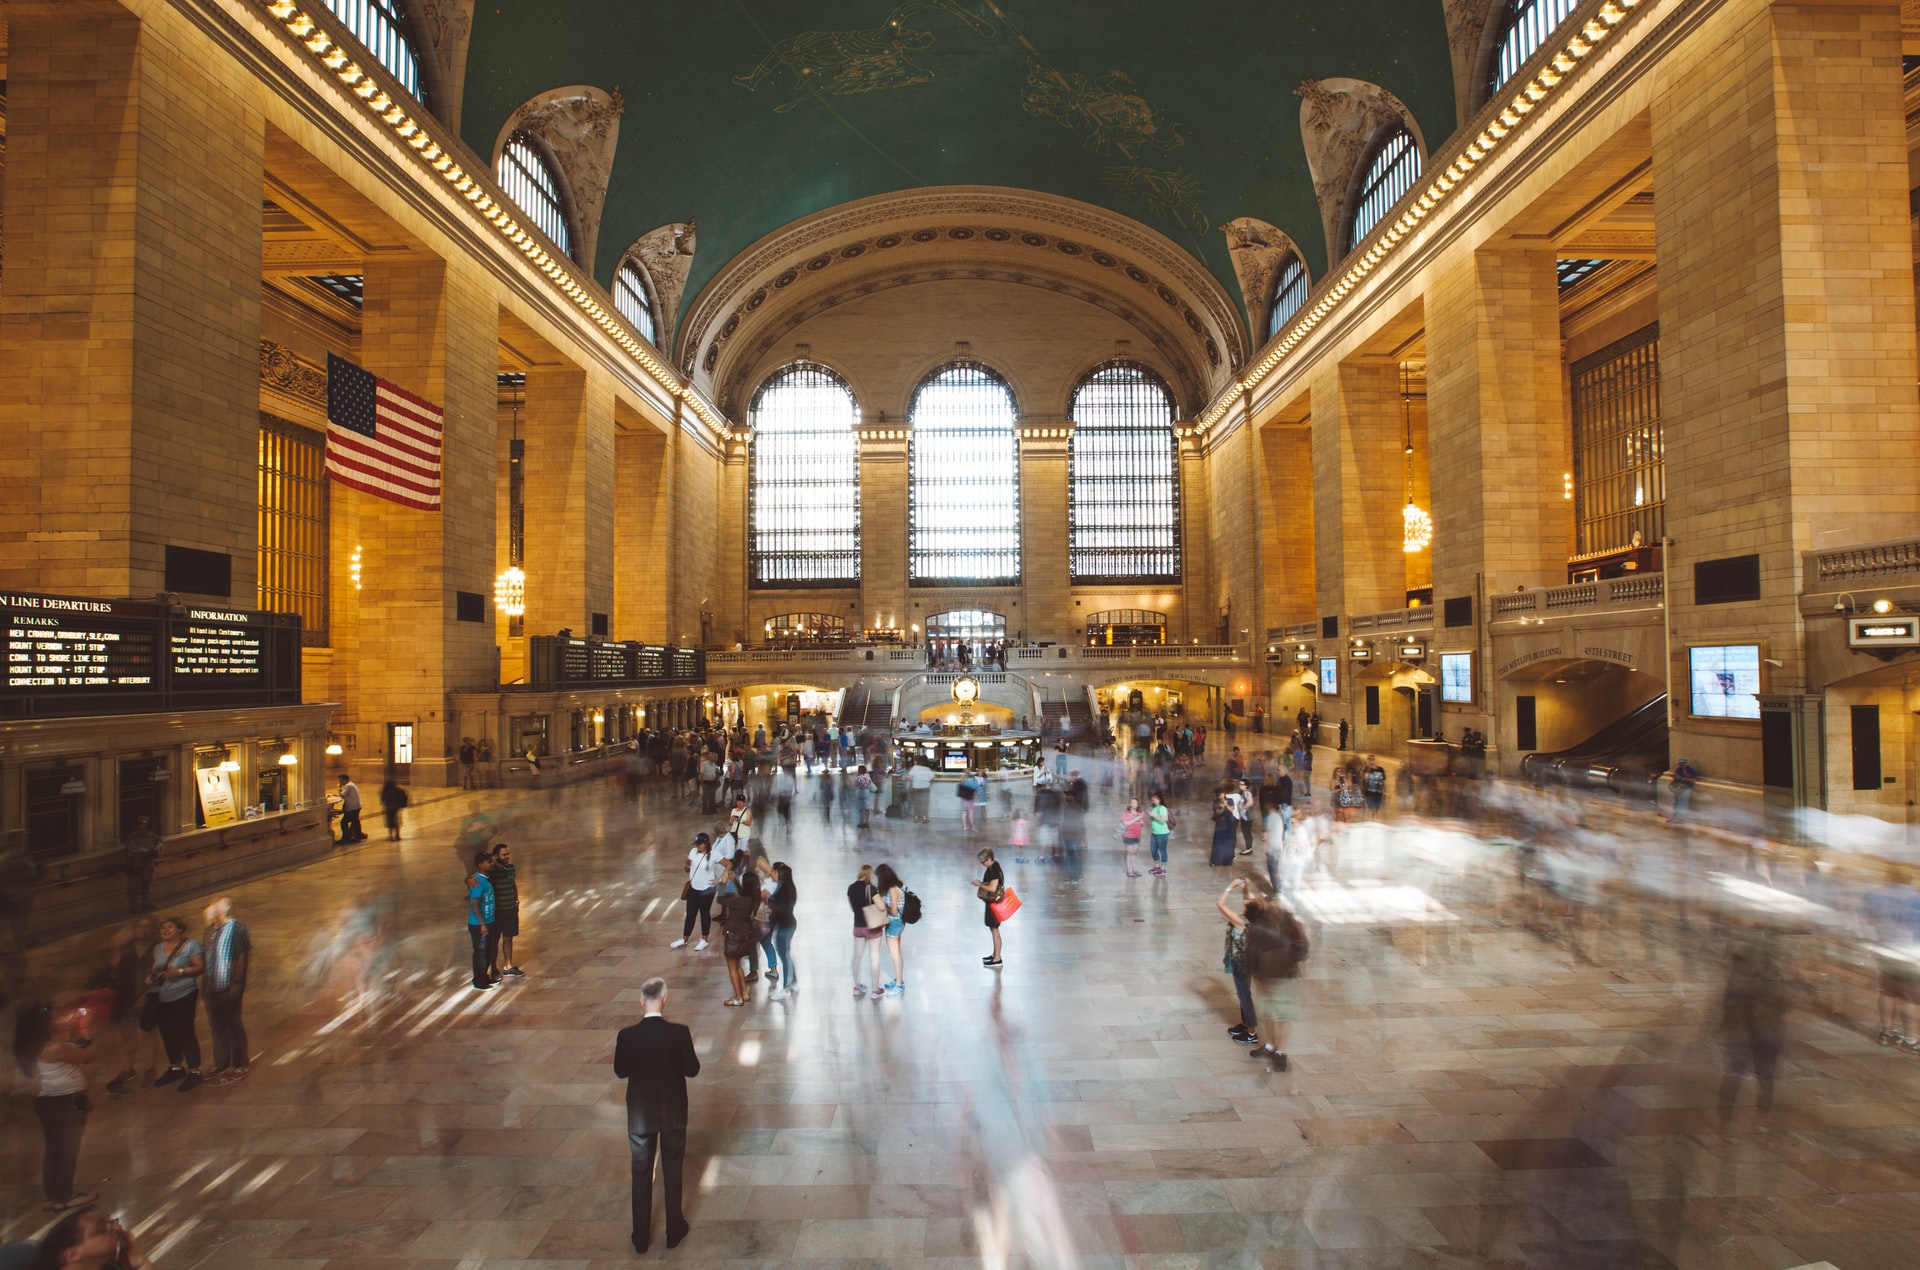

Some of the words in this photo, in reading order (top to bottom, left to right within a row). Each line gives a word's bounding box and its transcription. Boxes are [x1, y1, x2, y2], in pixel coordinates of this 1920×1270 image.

[11, 596, 40, 608] LINE
[42, 599, 112, 613] DEPARTURES
[190, 610, 248, 622] INFORMATION
[13, 616, 59, 626] REMARKS
[9, 629, 24, 638] NEW
[9, 642, 32, 650] MOUNT
[89, 643, 105, 651] STOP
[37, 654, 46, 662] TO
[49, 654, 70, 662] SHORE
[73, 654, 90, 662] LINE
[92, 655, 108, 663] EAST
[1584, 647, 1603, 657] 45TH
[1603, 648, 1633, 663] STREET
[1497, 664, 1509, 676] THE
[1531, 647, 1562, 661] BUILDING
[9, 666, 32, 674] MOUNT
[89, 666, 105, 674] STOP
[9, 677, 54, 686] CONNECTION
[58, 677, 66, 685] TO
[69, 677, 82, 685] NEW
